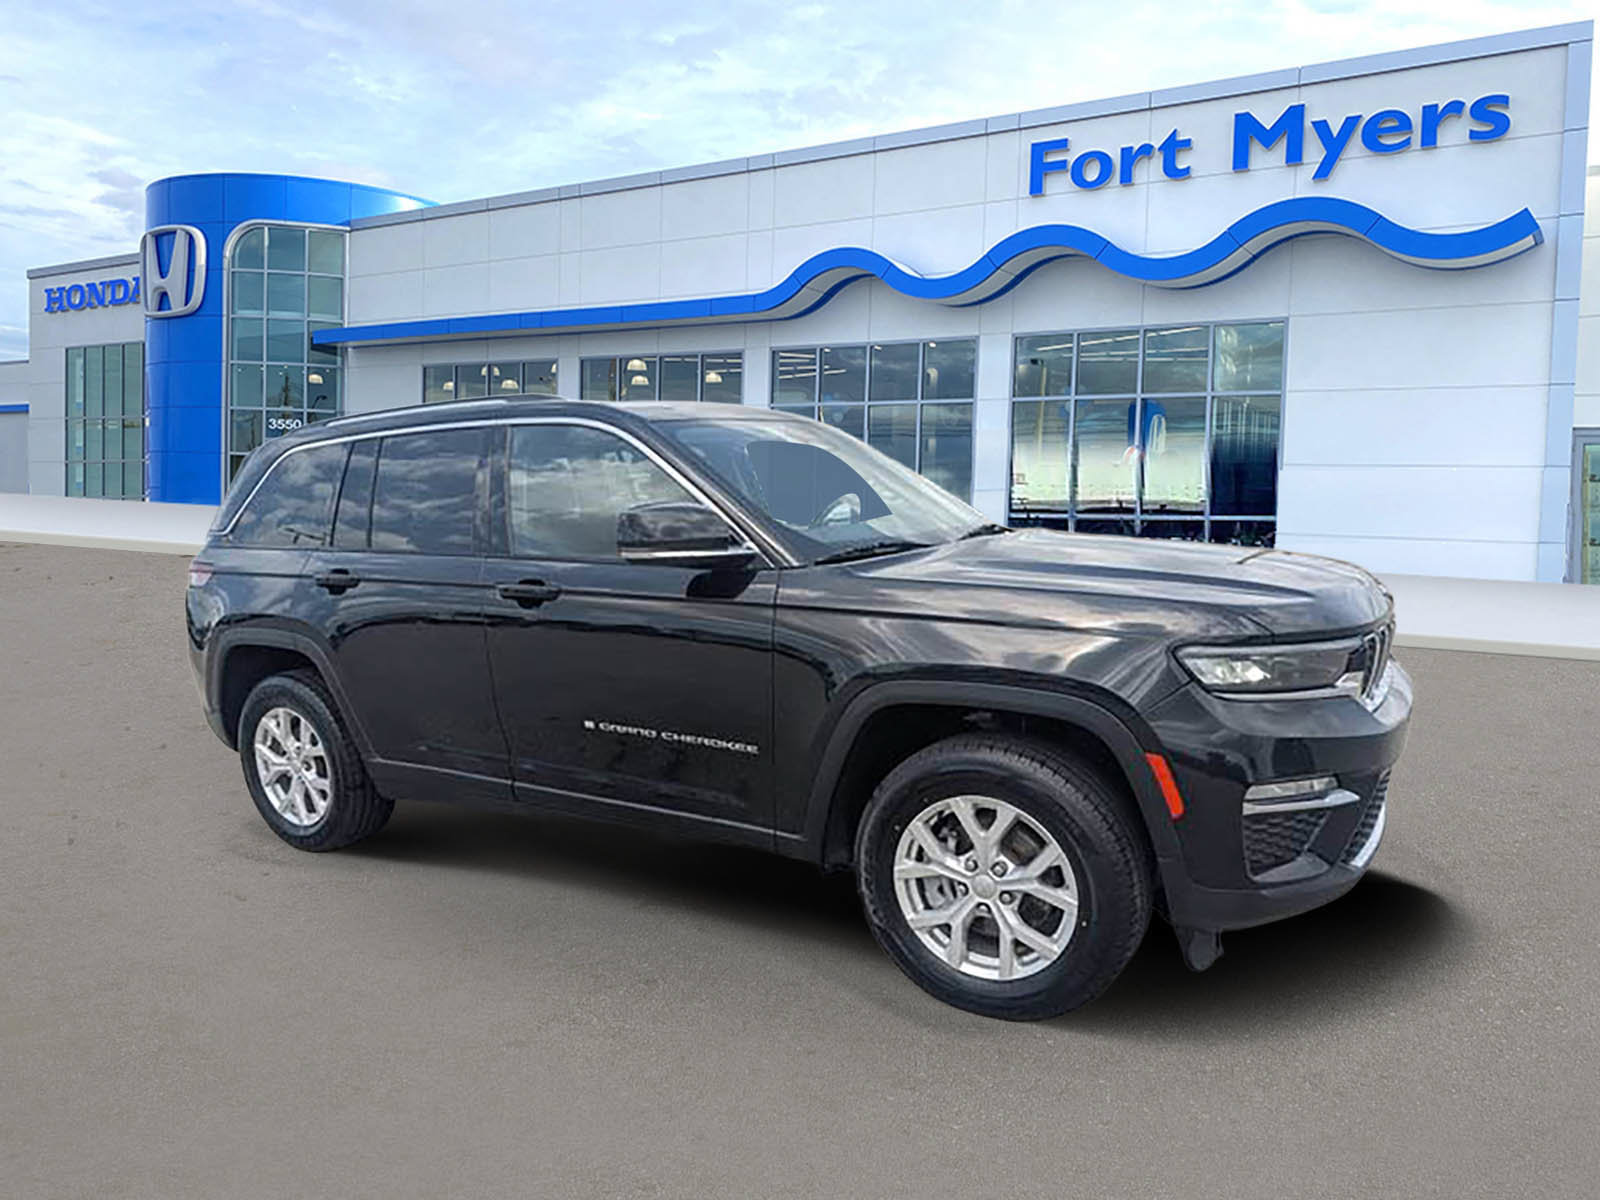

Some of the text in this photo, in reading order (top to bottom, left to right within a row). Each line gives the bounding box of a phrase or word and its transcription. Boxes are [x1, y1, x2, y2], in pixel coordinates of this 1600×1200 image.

[1029, 94, 1511, 197] Fort Myers
[268, 418, 302, 430] 3550
[599, 722, 759, 754] GRAND CHEROKEE
